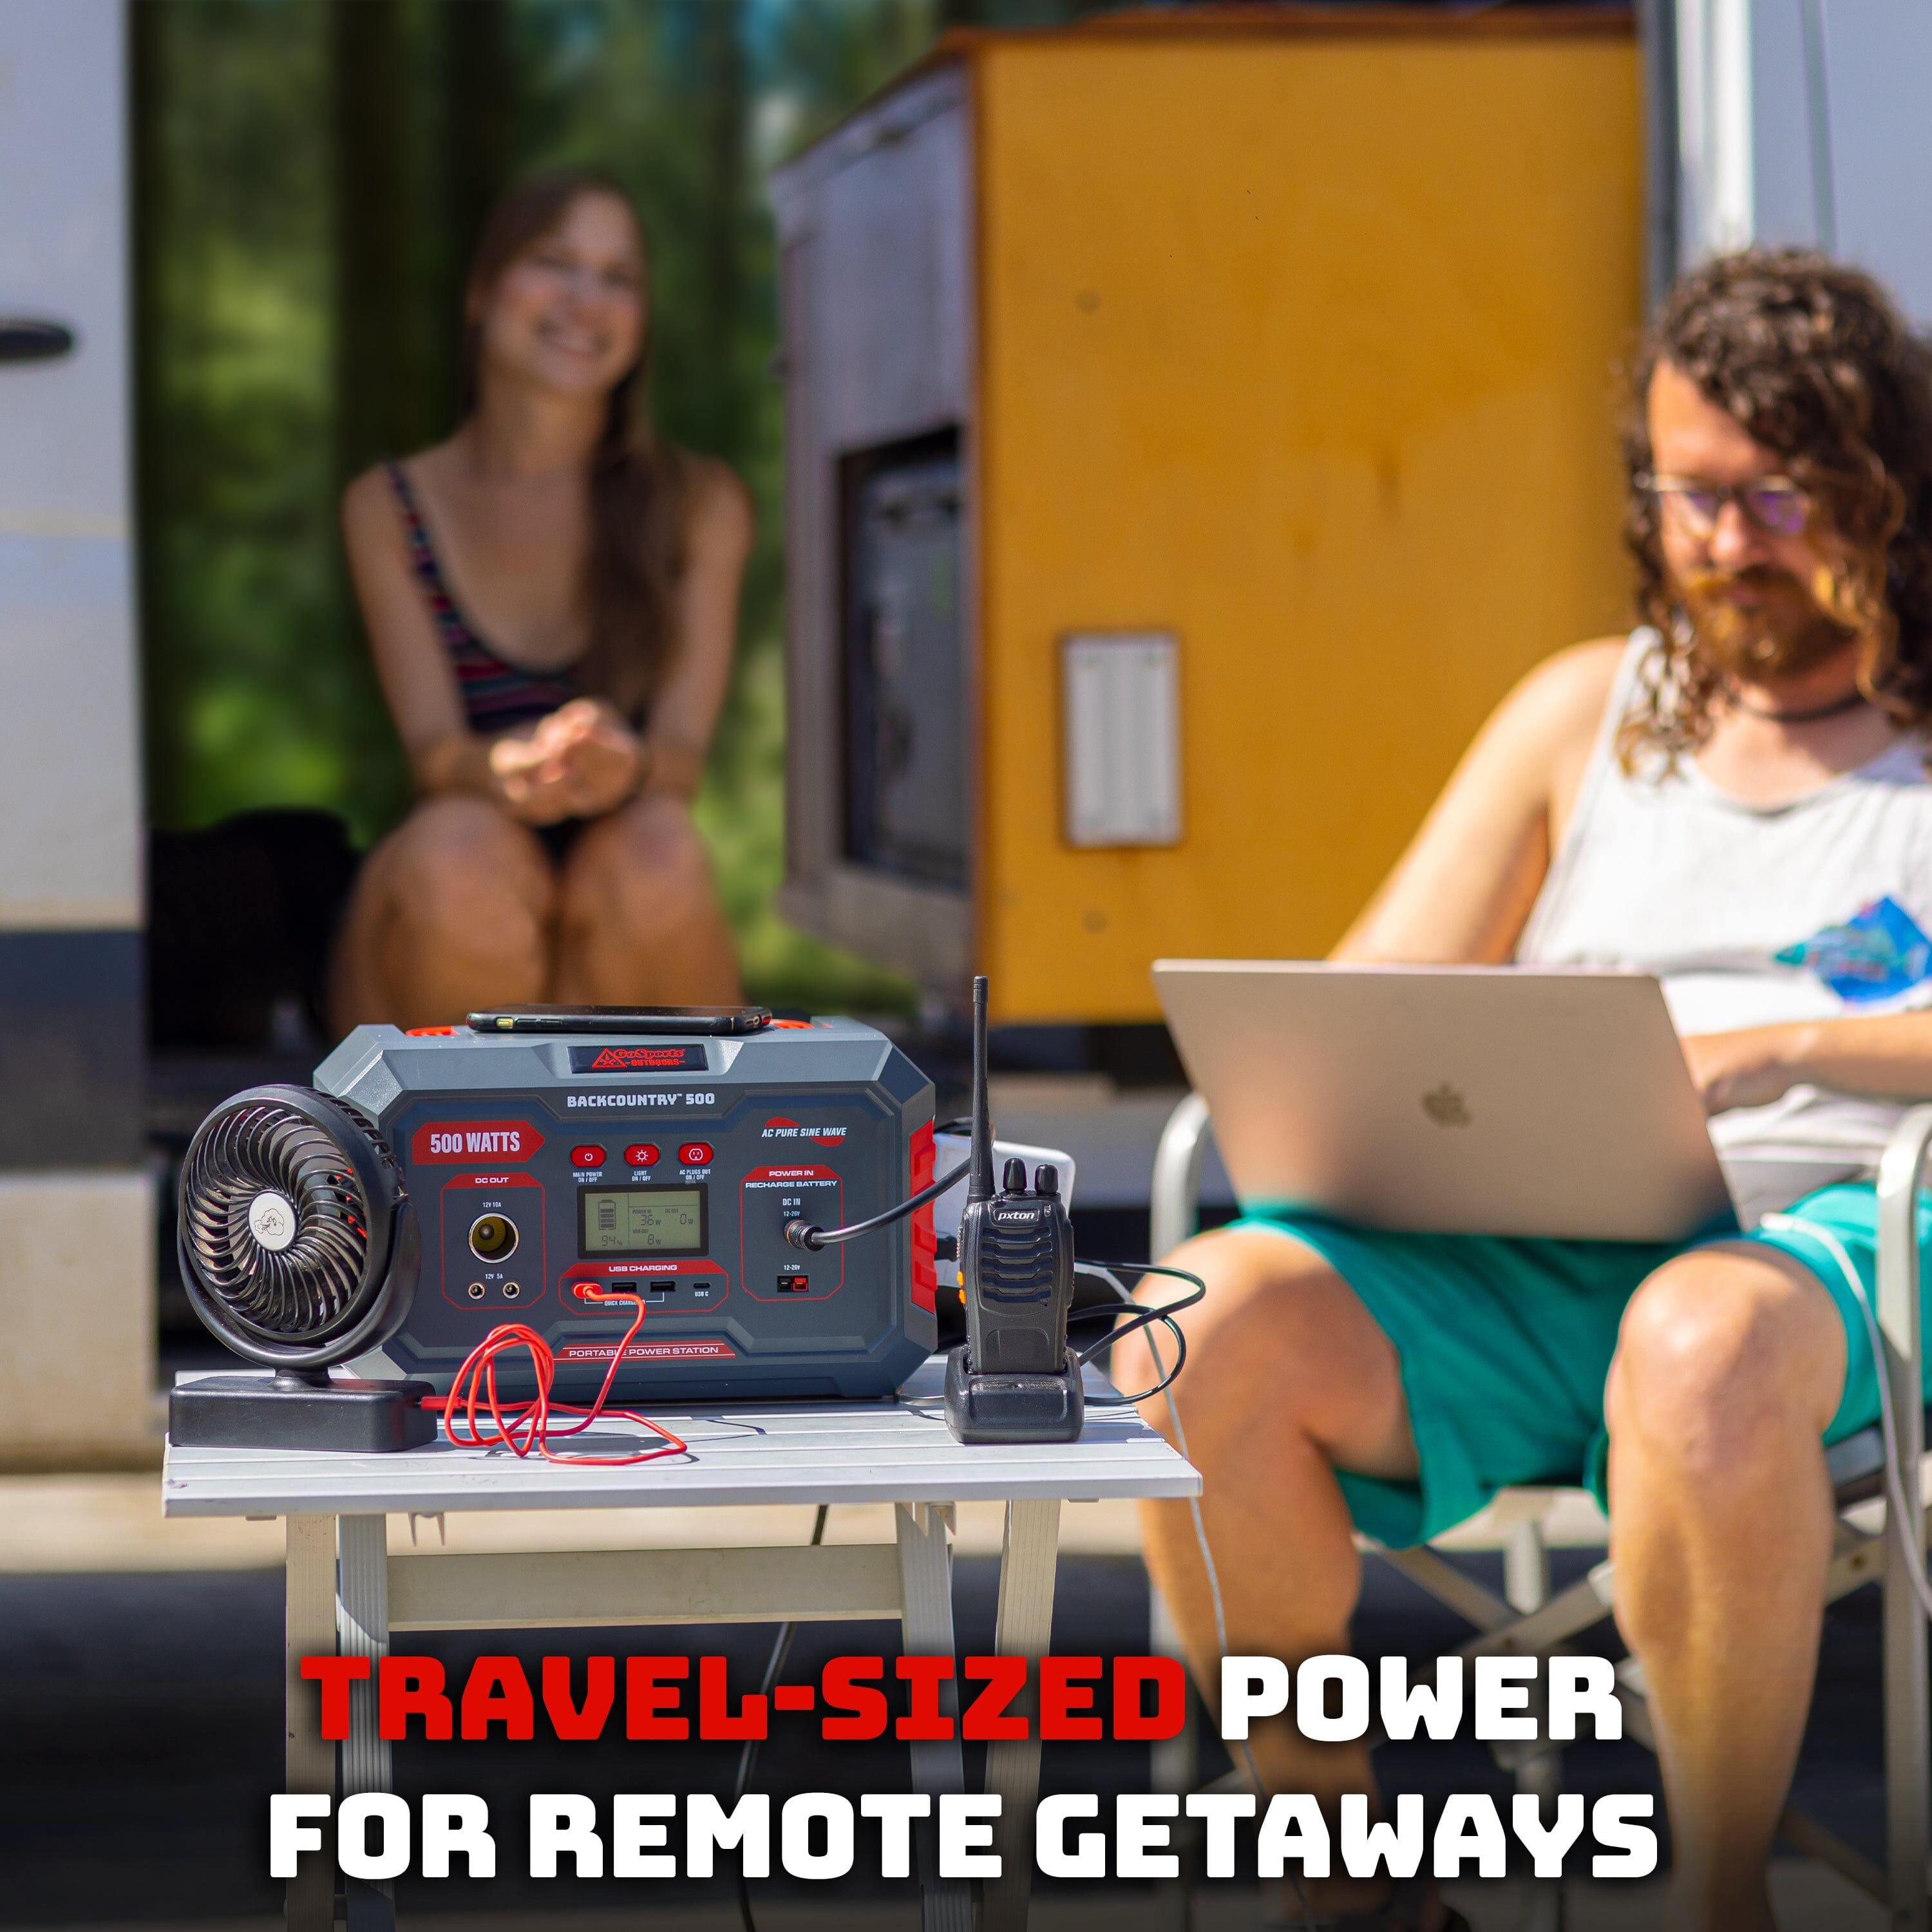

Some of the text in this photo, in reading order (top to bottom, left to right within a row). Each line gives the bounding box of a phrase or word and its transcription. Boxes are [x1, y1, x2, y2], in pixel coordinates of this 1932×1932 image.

[613, 1048, 685, 1059] GoSports
[686, 1093, 715, 1105] 500
[761, 1127, 847, 1137] AC PURE SINE WAVE
[430, 1132, 520, 1153] 500 WATTS
[998, 1212, 1034, 1221] pxton
[672, 1347, 719, 1355] STATION
